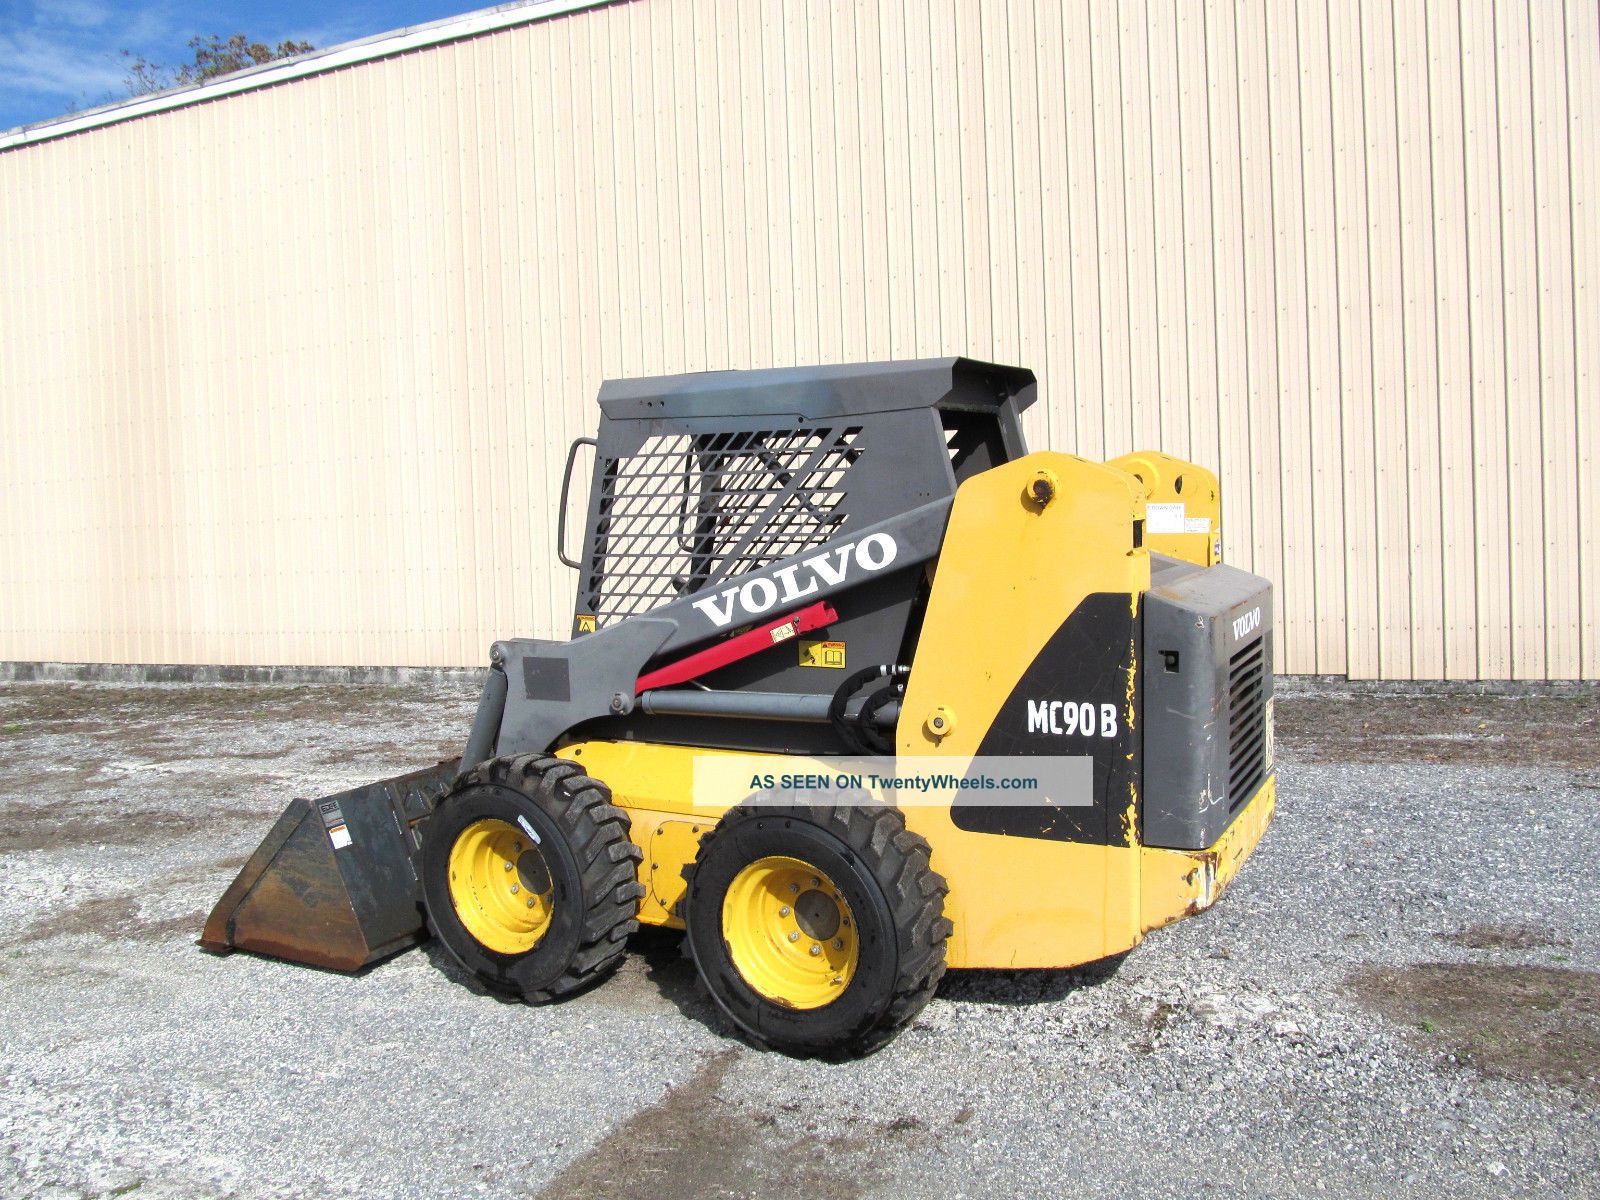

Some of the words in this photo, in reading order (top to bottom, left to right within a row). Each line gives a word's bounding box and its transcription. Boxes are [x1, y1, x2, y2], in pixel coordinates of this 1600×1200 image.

[692, 533, 897, 627] VOLVO
[1232, 606, 1260, 641] VOLVO
[1027, 700, 1095, 736] MC90
[1100, 703, 1118, 737] B
